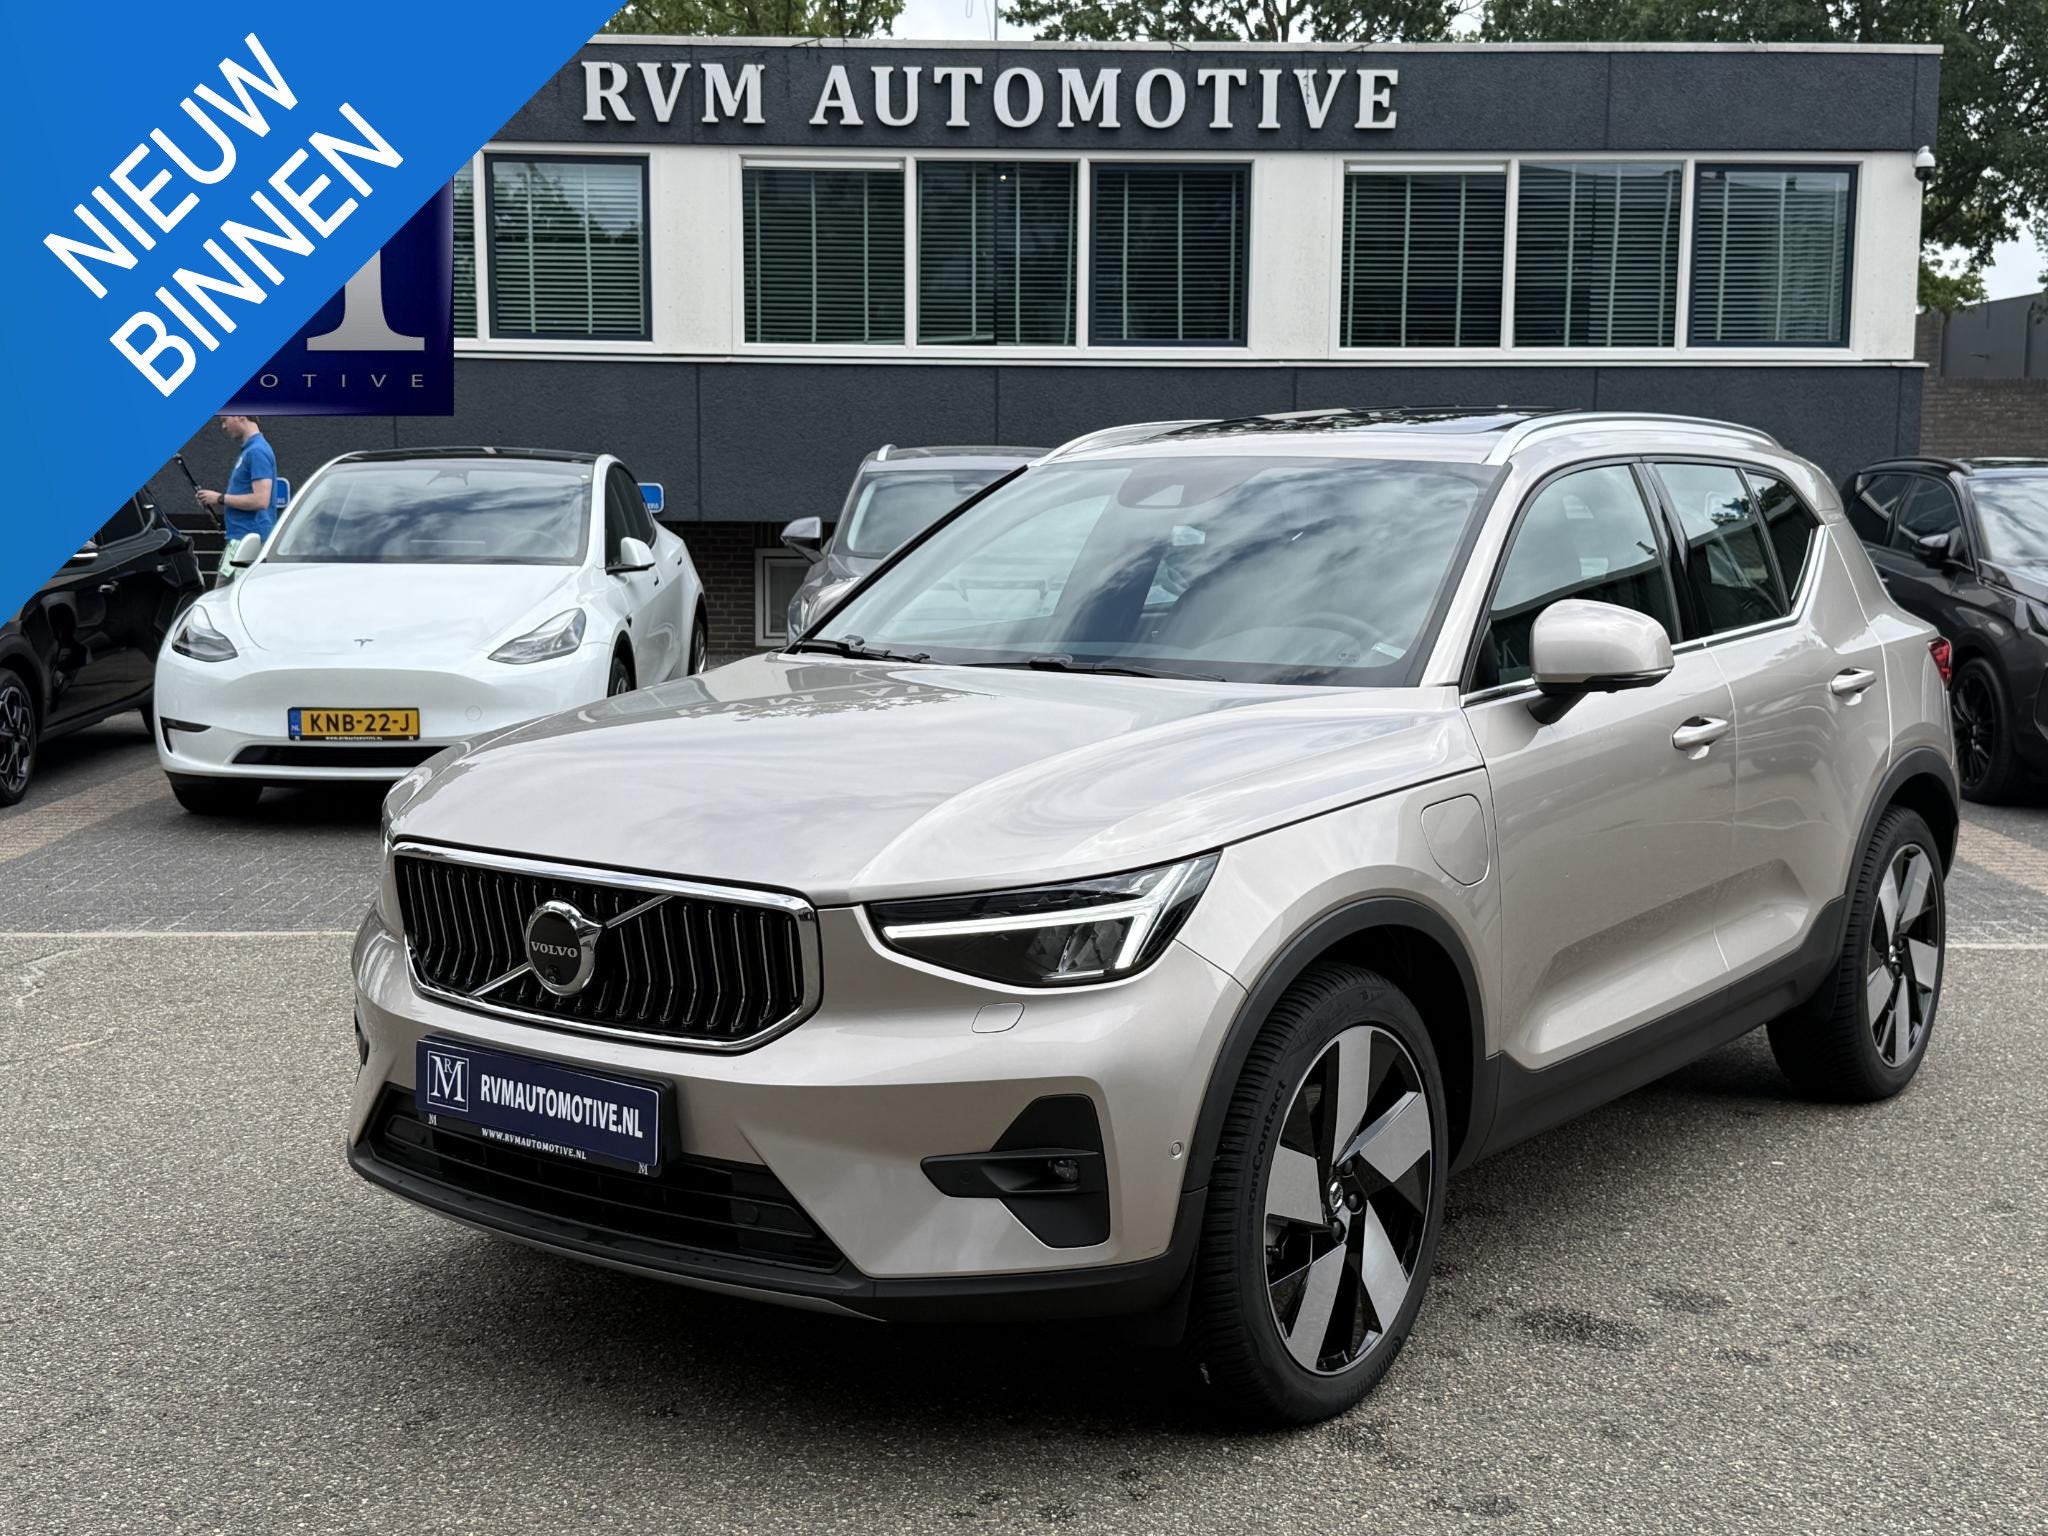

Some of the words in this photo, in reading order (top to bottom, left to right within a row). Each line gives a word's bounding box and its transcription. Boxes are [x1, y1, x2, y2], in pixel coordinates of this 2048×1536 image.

[582, 61, 765, 124] RVM
[809, 65, 1399, 129] AUTOMOTIVE
[310, 713, 410, 732] KNB-22-J
[531, 941, 578, 958] VOLVO
[481, 1074, 643, 1138] RVMAUTOMOTIVE.NL
[482, 1127, 587, 1160] WWW.RVMAUTOMOTIVE.NL
